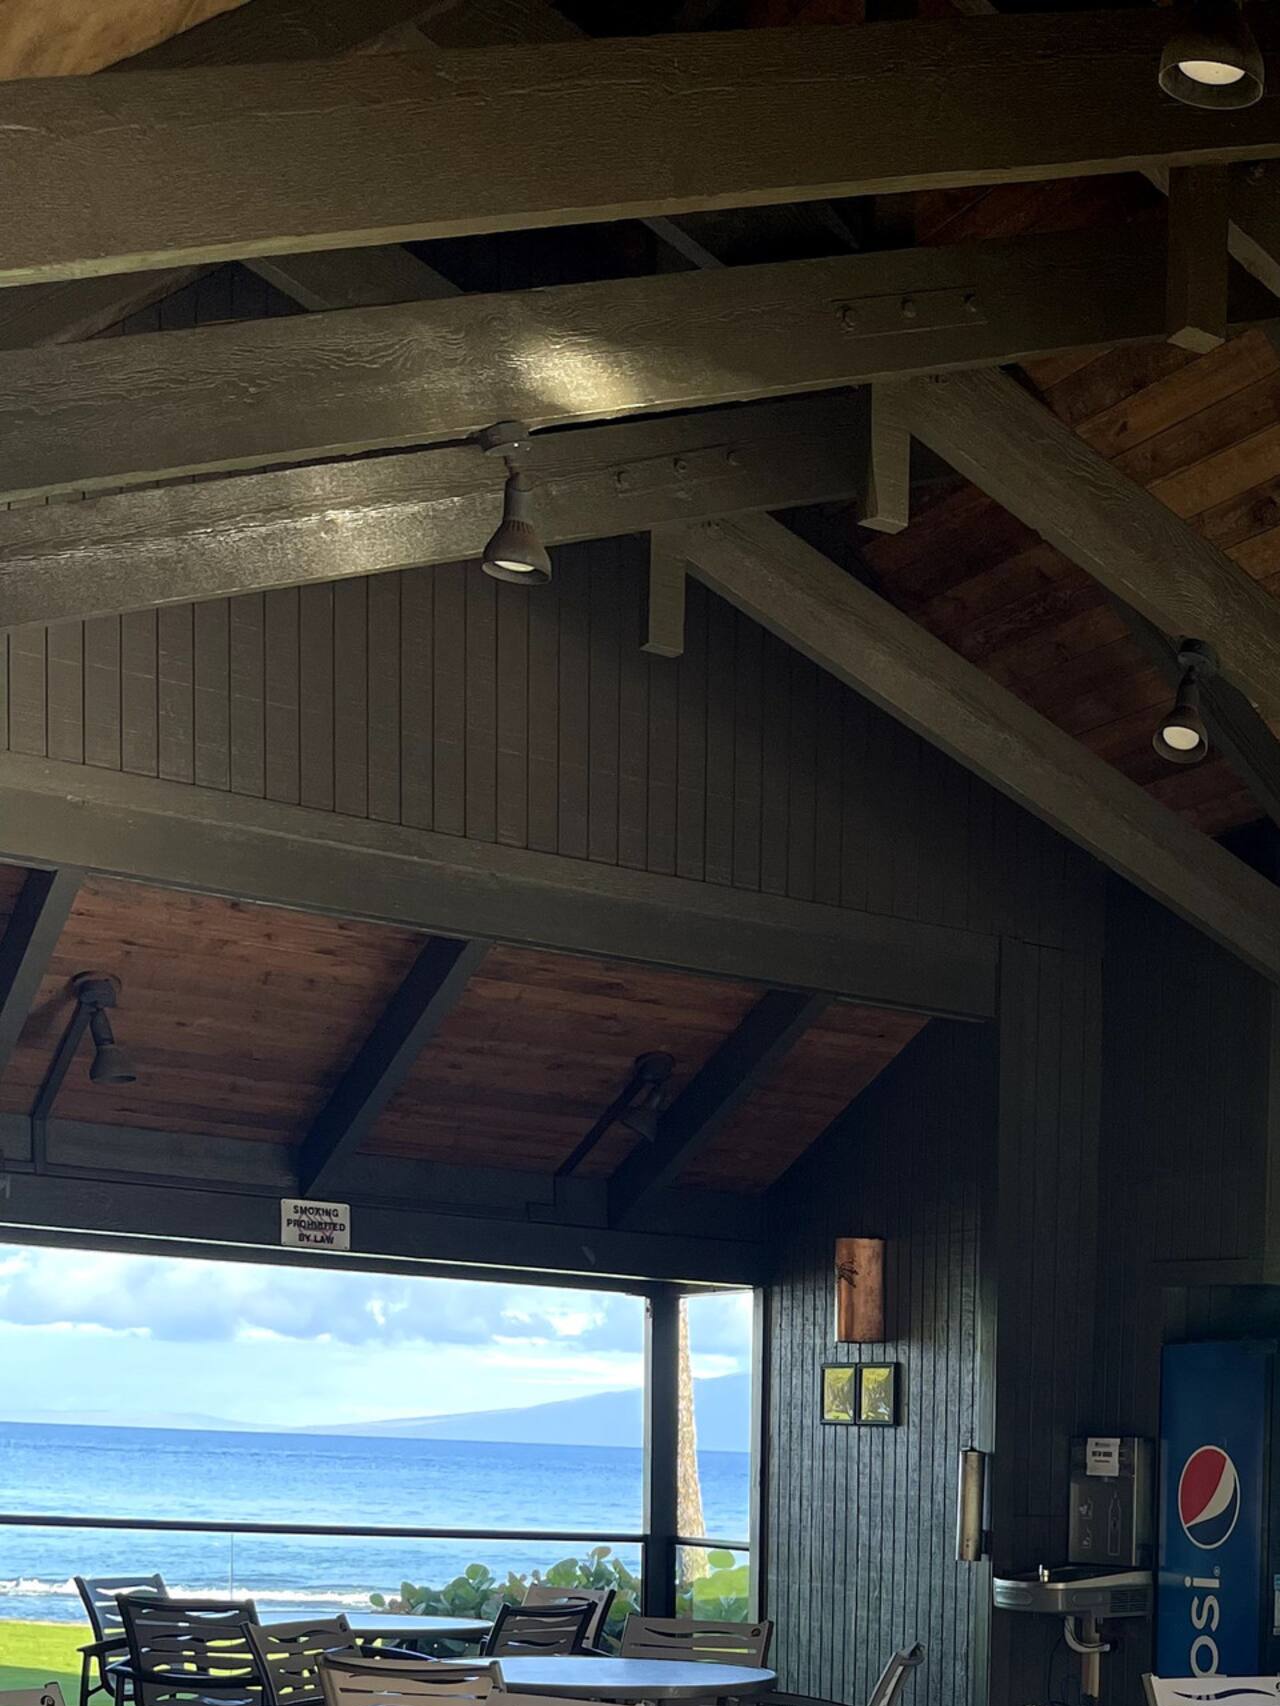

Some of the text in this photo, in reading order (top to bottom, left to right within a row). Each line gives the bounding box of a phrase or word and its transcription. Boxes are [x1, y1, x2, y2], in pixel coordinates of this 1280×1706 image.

[293, 1205, 339, 1217] SMOKING
[286, 1218, 346, 1231] PROHIBITED
[298, 1232, 335, 1244] BY LAW
[1184, 1575, 1227, 1678] psi
